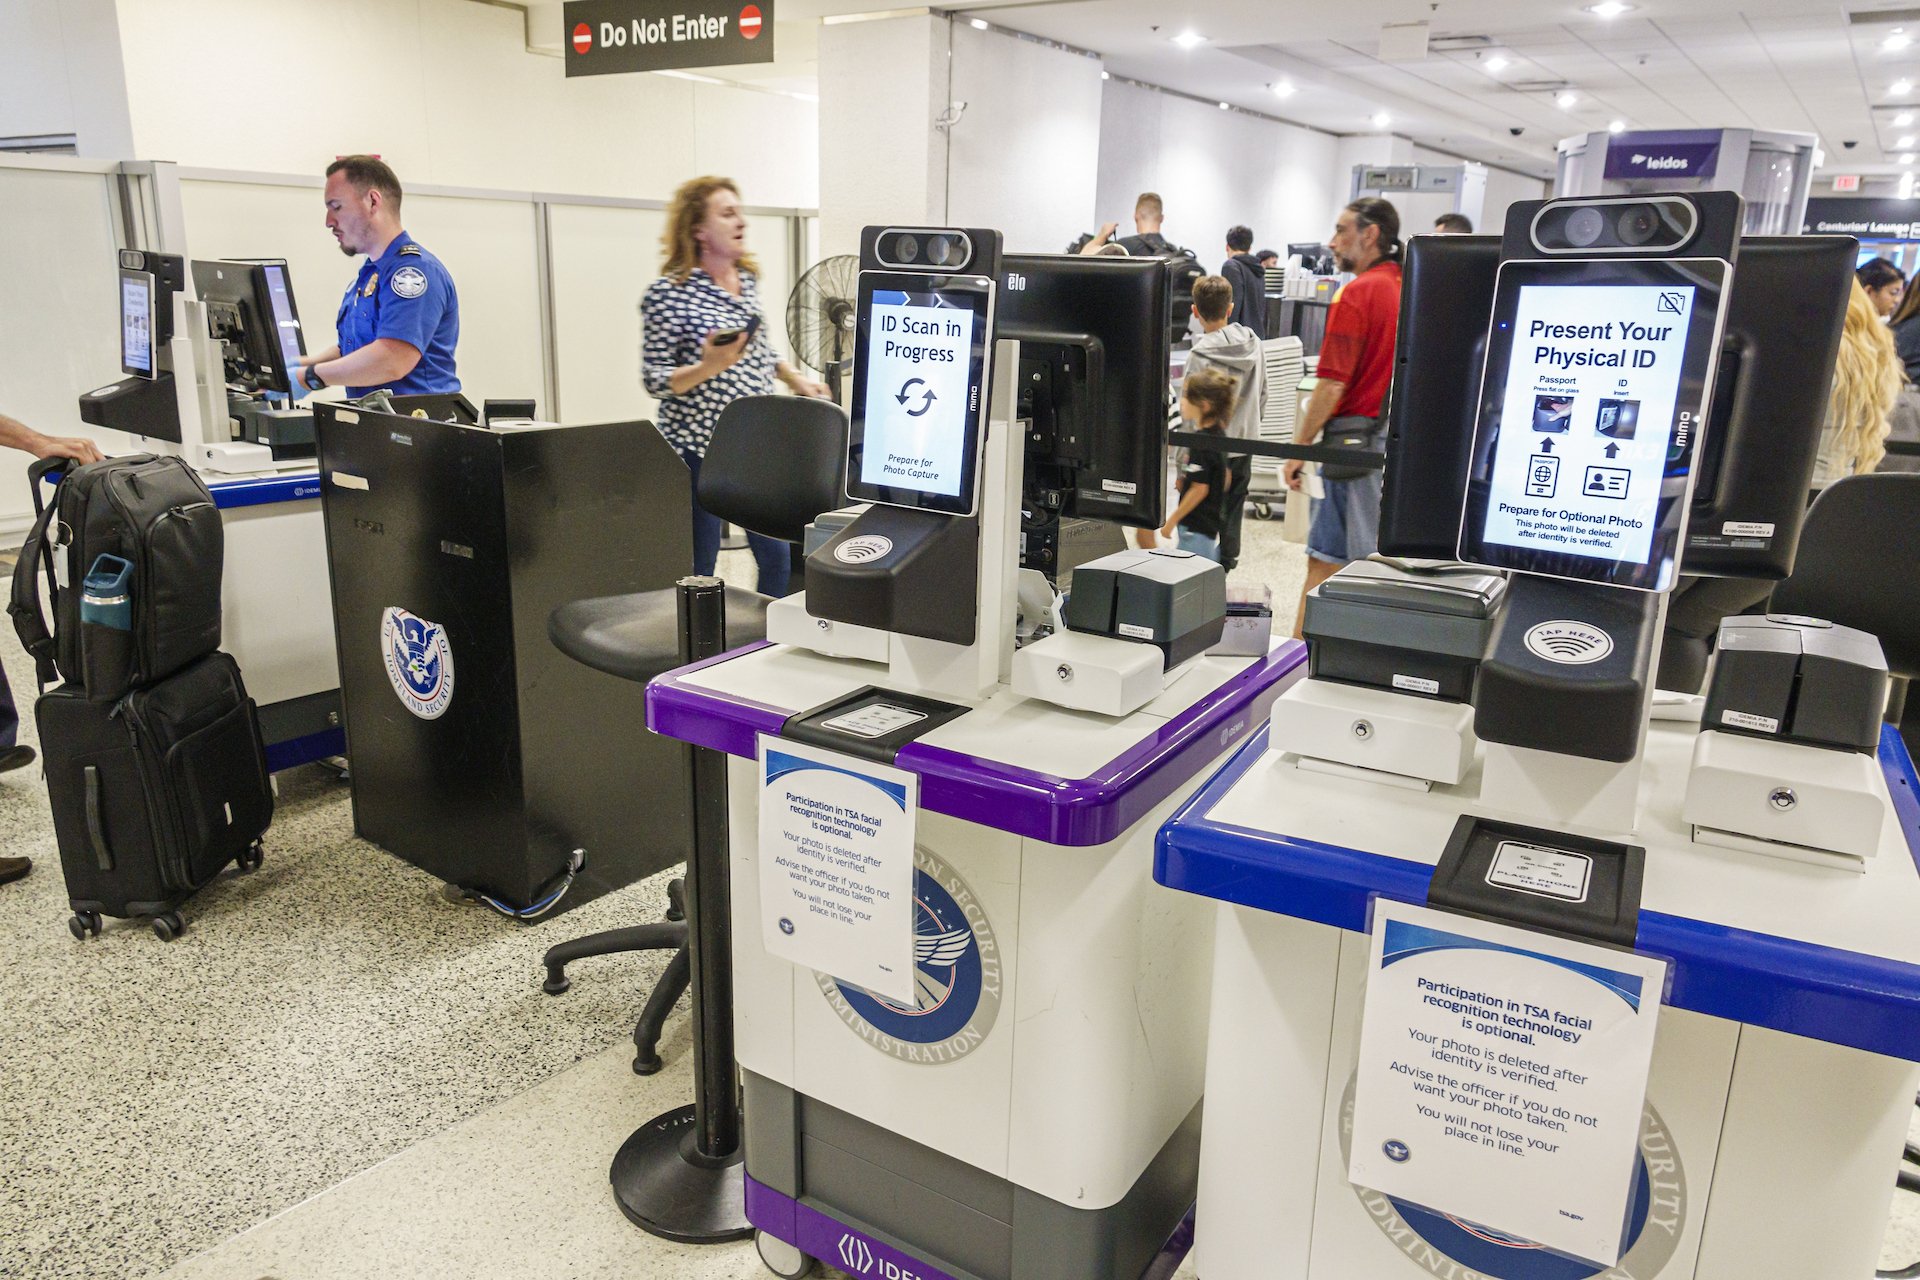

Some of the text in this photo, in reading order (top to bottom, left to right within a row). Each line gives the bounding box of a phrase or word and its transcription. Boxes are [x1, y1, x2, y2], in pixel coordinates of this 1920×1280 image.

[600, 14, 728, 47] Do Not Enter
[1647, 156, 1688, 170] leidos
[882, 315, 961, 337] ID Scan in
[1530, 320, 1672, 341] Present Your
[886, 340, 954, 363] Progress
[1534, 346, 1656, 370] Physical ID
[1540, 376, 1576, 385] Passport
[1618, 379, 1628, 387] ID
[1676, 411, 1690, 447] mimo
[883, 465, 939, 480] Photo Capture
[888, 454, 933, 468] Prepare for
[1499, 503, 1642, 528] Prepare for Optional Photo
[1516, 519, 1532, 527] This
[1534, 522, 1558, 530] photo
[1576, 526, 1586, 534] be
[1588, 528, 1620, 538] deleted
[1518, 530, 1536, 538] after
[1538, 532, 1568, 544] identity
[1580, 539, 1612, 548] verified.
[1568, 630, 1603, 644] HERE
[386, 654, 451, 714] HOMELAND SECURITY
[786, 792, 882, 827] Participation in TSA facial
[790, 805, 876, 837] recognition technology
[812, 820, 853, 840] is optional.
[783, 830, 882, 867] Your photo is deleted after
[797, 844, 825, 862] identity
[835, 858, 866, 874] verified.
[775, 856, 890, 900] Advise the officer if you do not
[789, 871, 874, 904] want your photo taken.
[1497, 870, 1578, 890] PLACE PHONE
[792, 888, 872, 920] You will not lose your
[810, 905, 829, 916] place
[840, 913, 854, 925] line.
[948, 877, 1000, 998] SECURITY
[1418, 977, 1592, 1030] Participation in TSA facial
[1423, 995, 1582, 1044] recognition technology
[1462, 1016, 1535, 1046] is optional.
[1409, 1028, 1588, 1085] Your photo is deleted after
[1432, 1050, 1557, 1092] identity is verified.
[1390, 1061, 1598, 1128] Advise the officer if you do not
[1414, 1082, 1567, 1133] want your photo taken.
[1416, 1104, 1560, 1152] You will not lose your
[1445, 1126, 1525, 1156] place in line.
[1559, 1210, 1584, 1221] tsa.gov
